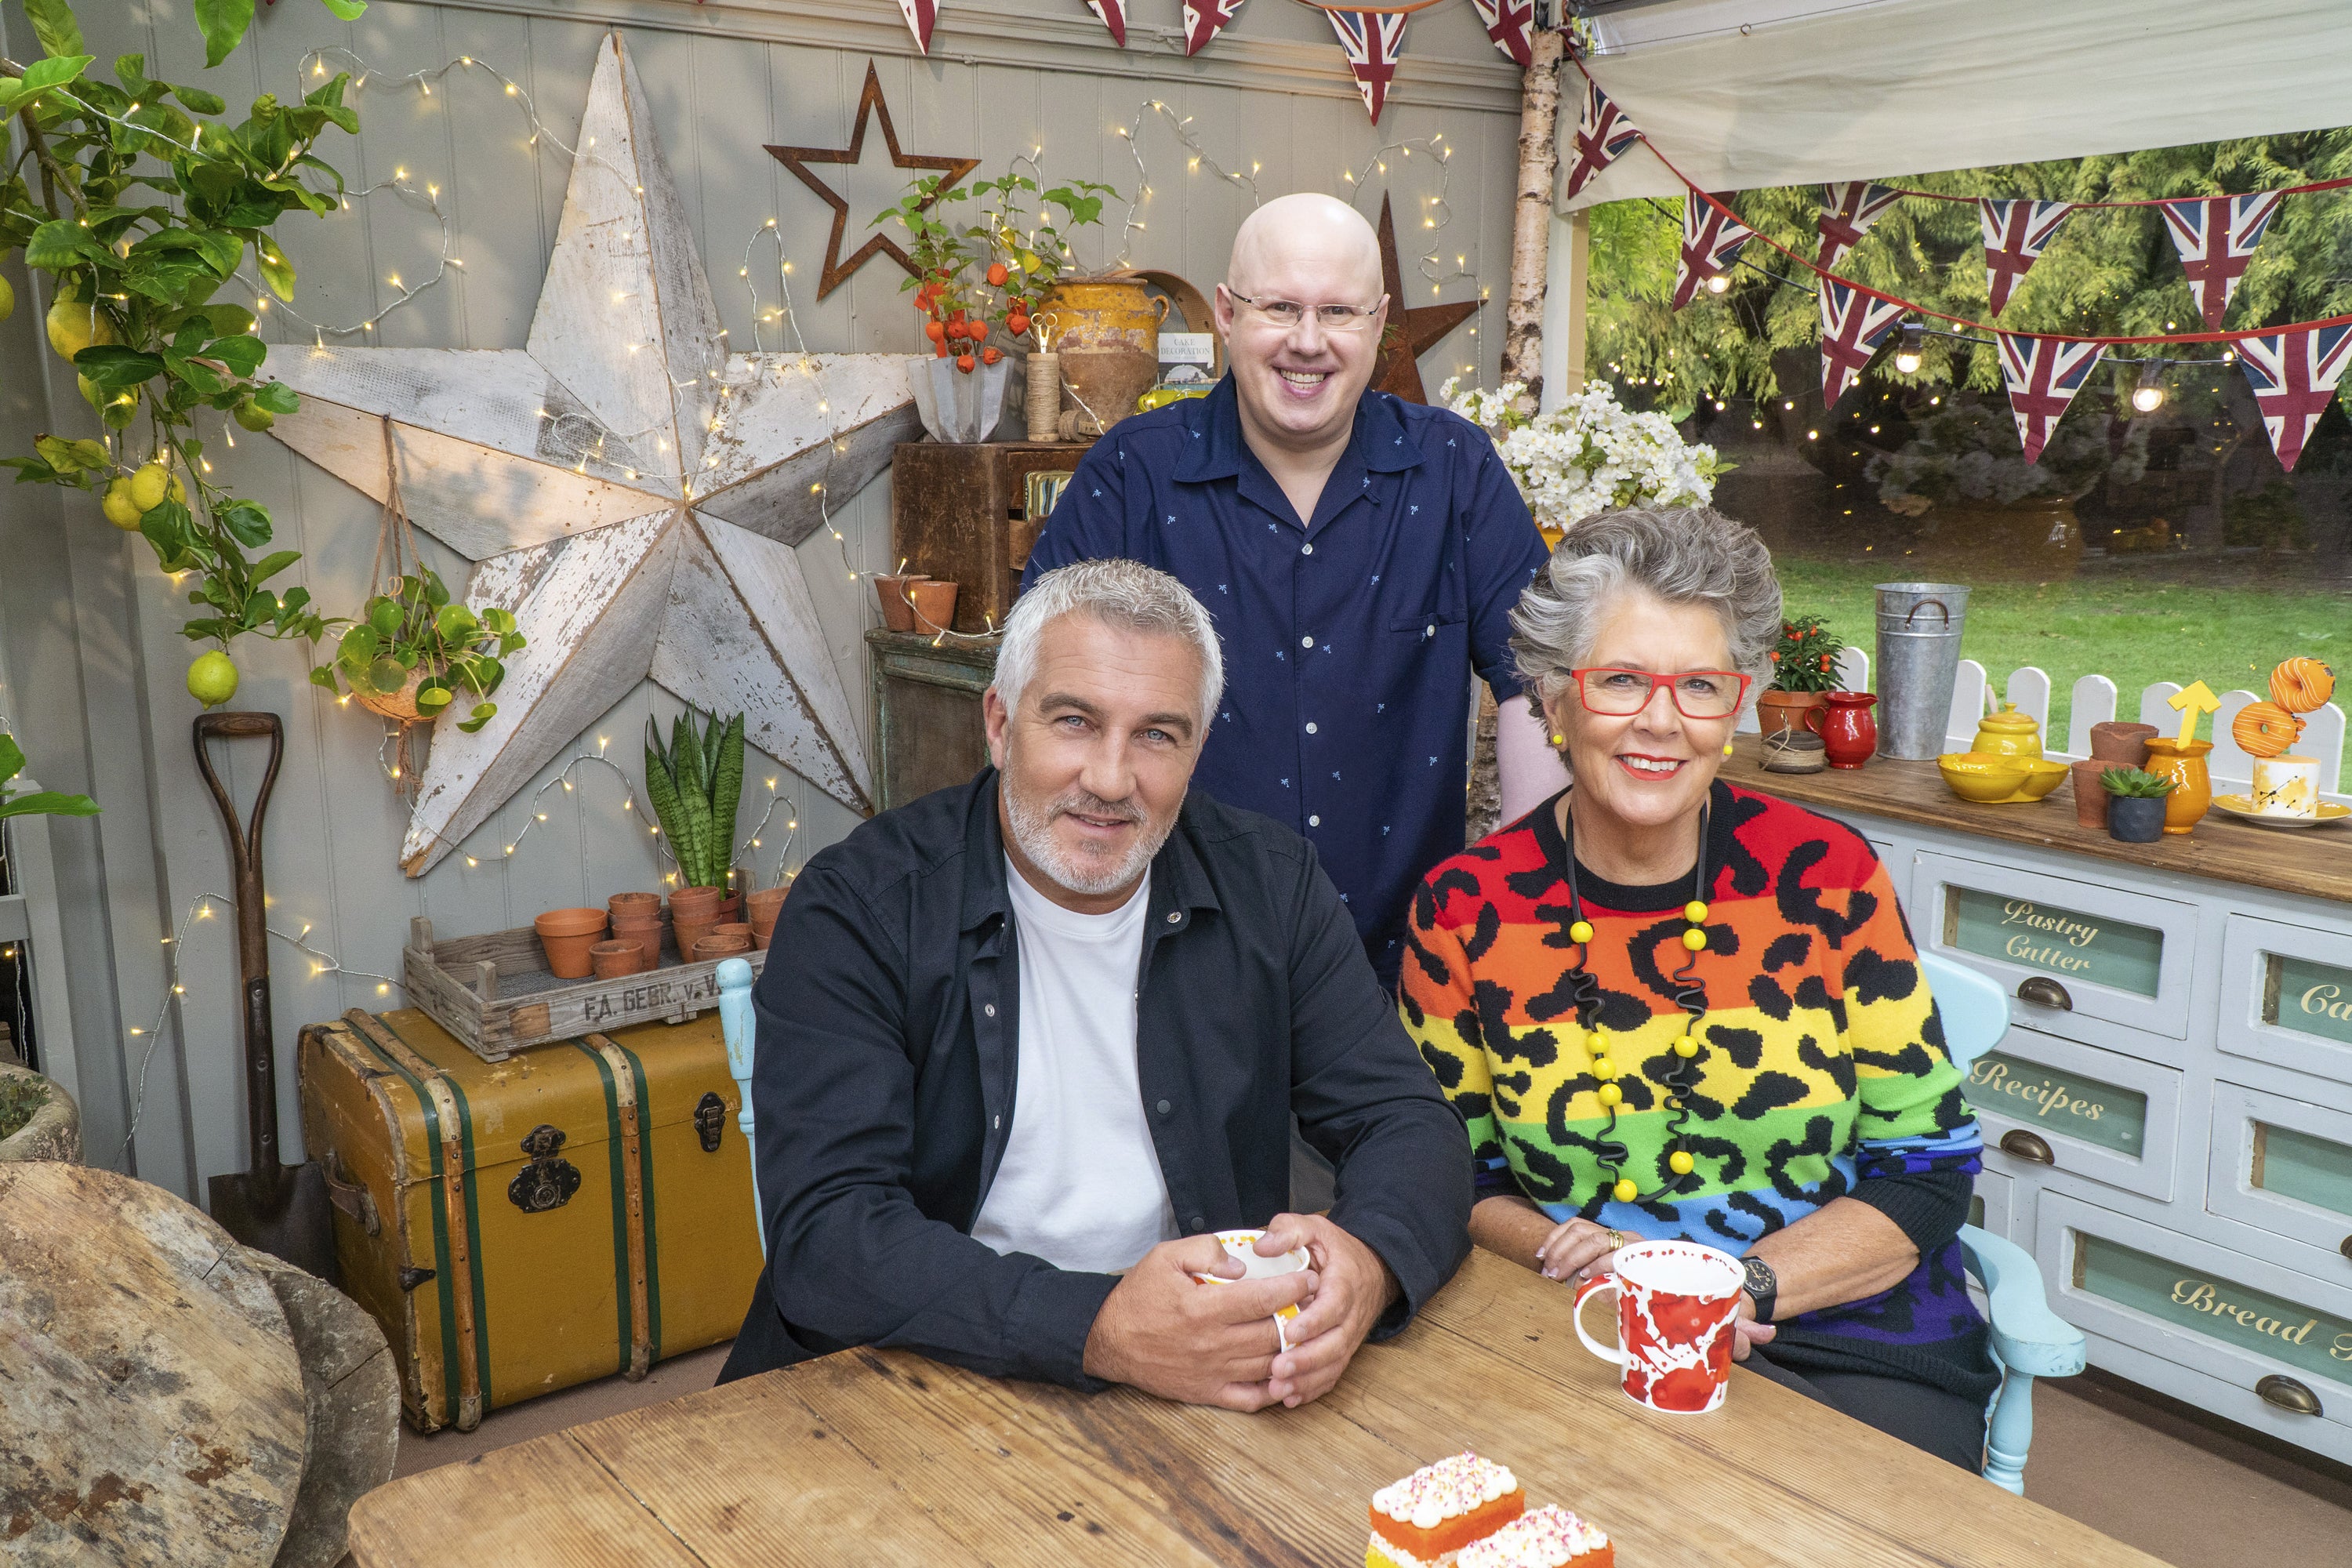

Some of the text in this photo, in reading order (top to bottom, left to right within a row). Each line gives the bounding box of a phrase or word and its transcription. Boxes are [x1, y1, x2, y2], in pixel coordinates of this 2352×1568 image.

[2001, 901, 2099, 947] Pastry
[2005, 935, 2091, 971] Cutter
[623, 982, 677, 1011] GEBR.
[1969, 1060, 2105, 1120] Recipes
[2171, 1279, 2318, 1345] Bread
